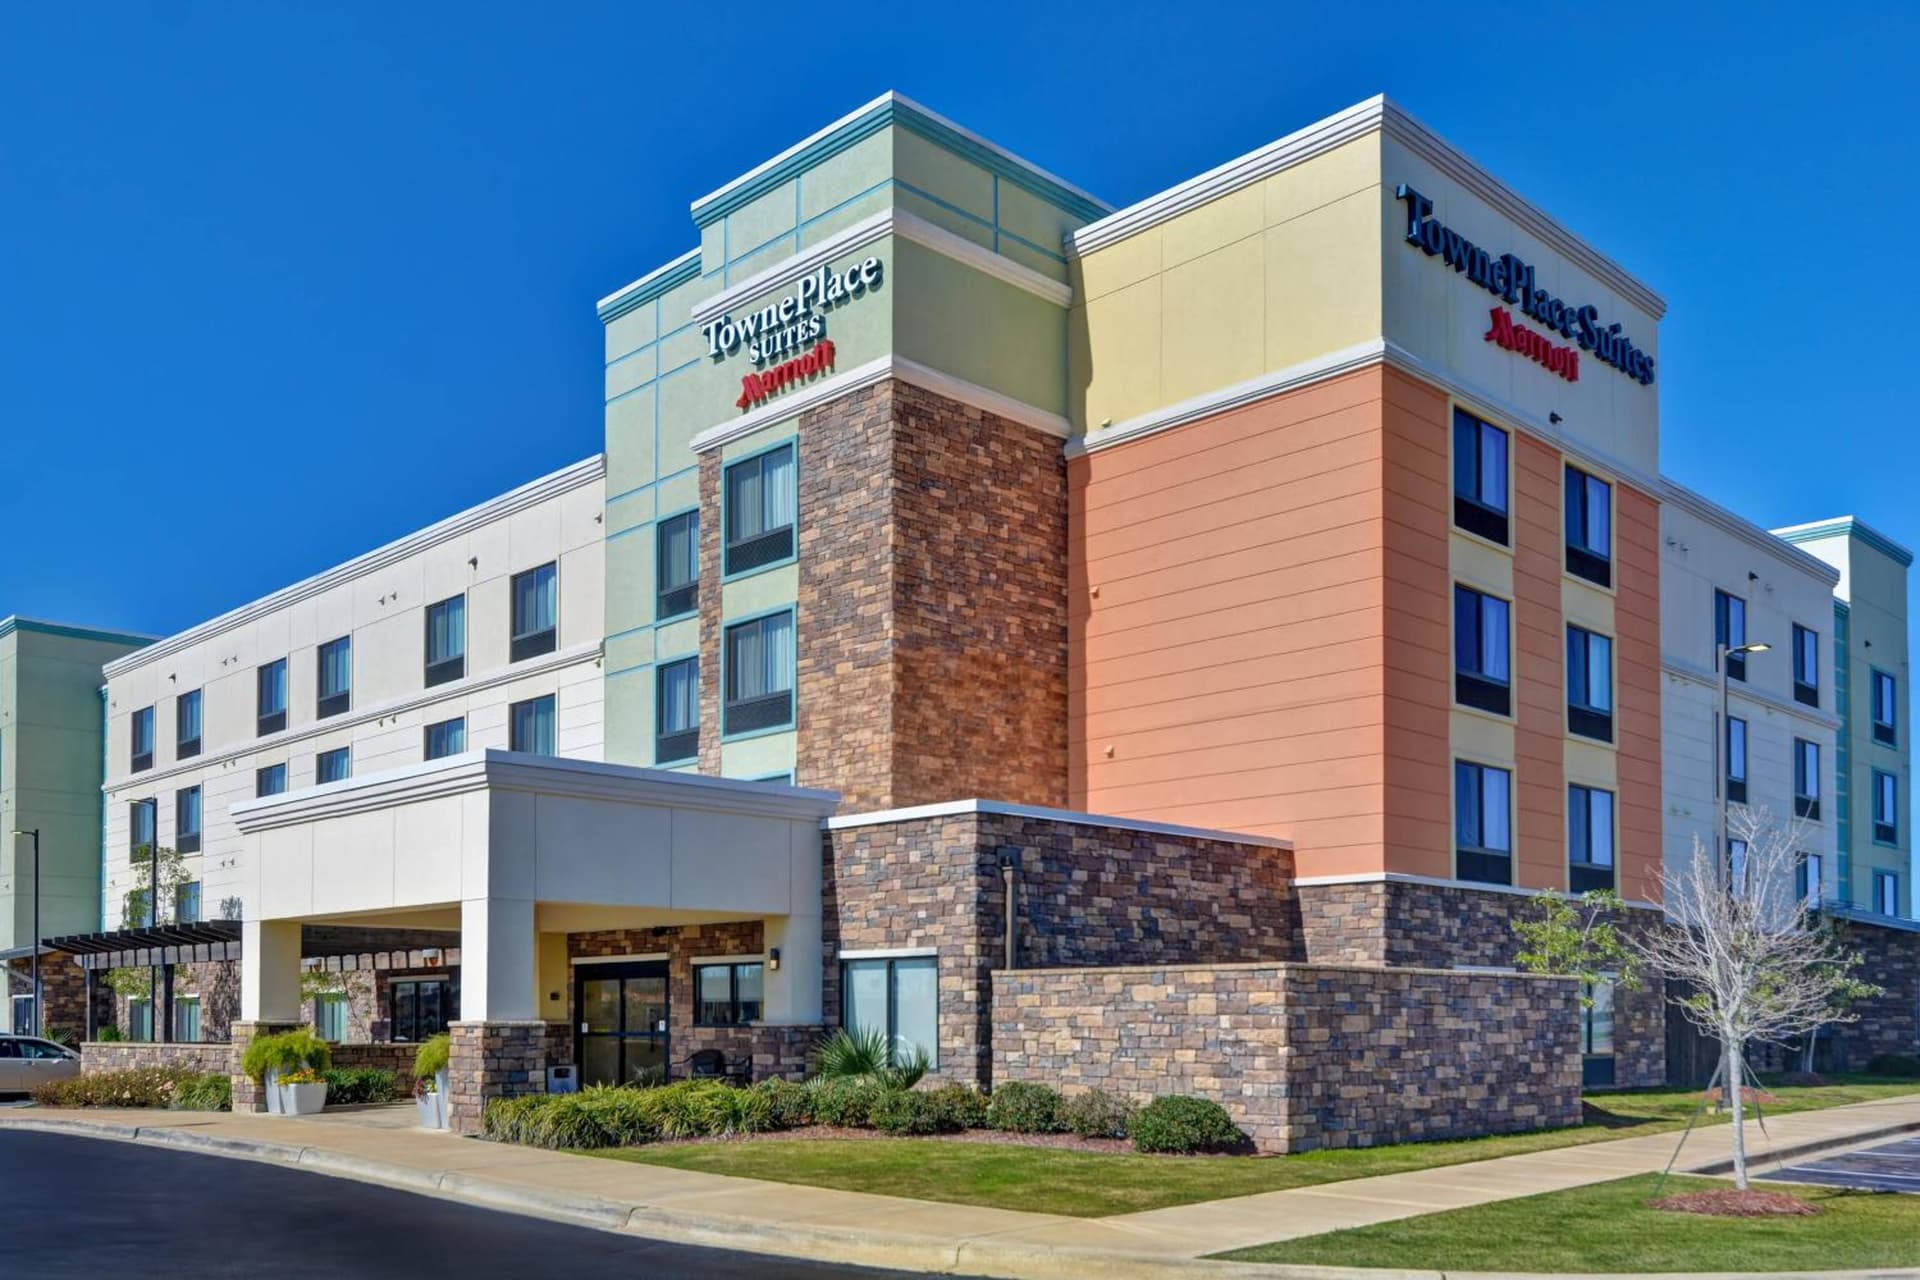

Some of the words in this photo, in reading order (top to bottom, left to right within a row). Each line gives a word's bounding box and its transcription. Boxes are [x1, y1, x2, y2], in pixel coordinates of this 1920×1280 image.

[702, 256, 883, 361] TownePlace
[749, 314, 826, 365] SUITES
[1484, 306, 1579, 382] Marriott
[736, 339, 835, 409] Marriott
